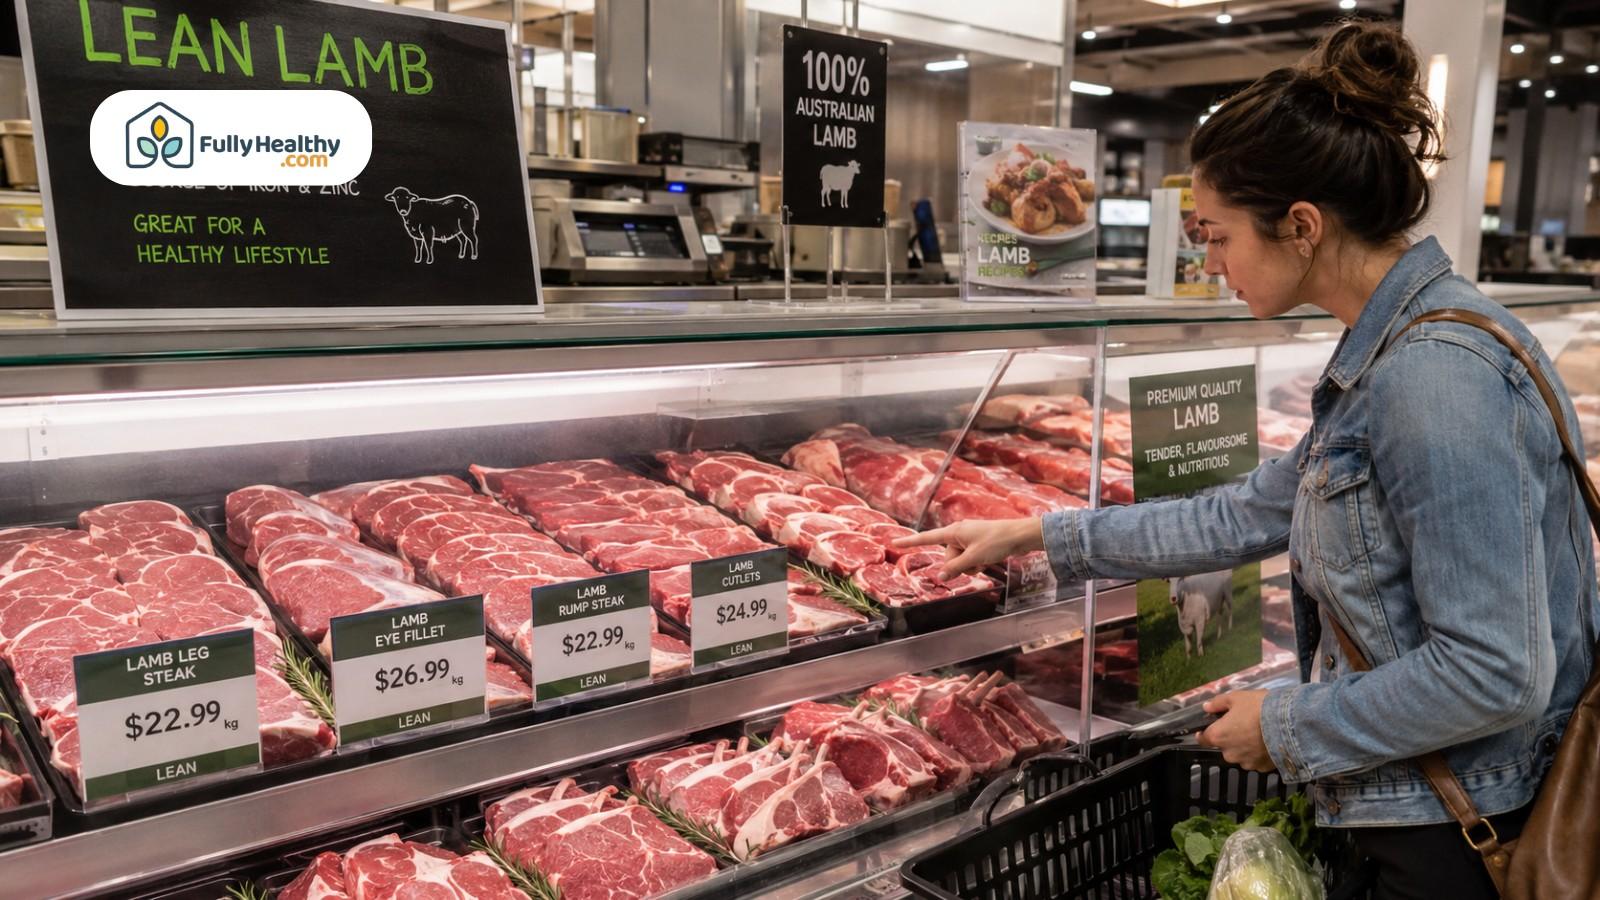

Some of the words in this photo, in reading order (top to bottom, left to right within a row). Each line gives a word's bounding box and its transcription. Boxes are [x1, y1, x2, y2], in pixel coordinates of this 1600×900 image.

[80, 0, 254, 77] LEAN
[275, 25, 434, 95] LAMB
[802, 49, 870, 97] 100%
[795, 96, 875, 123] AUSTRALIAN
[813, 123, 857, 149] LAMB
[133, 214, 197, 234] GREAT
[207, 217, 244, 235] FOR
[252, 217, 266, 236] A
[137, 244, 224, 264] HEALTHY
[234, 246, 330, 265] LIFESTYLE
[977, 246, 1031, 265] LAMB
[1147, 385, 1197, 406] PREMIUM
[1200, 379, 1242, 399] QUALITY
[1173, 402, 1220, 430] LAMB
[1144, 444, 1185, 463] TENDER,
[1186, 433, 1248, 454] FLAVOURSOME
[1168, 464, 1175, 478] &
[1178, 454, 1230, 475] NUTRITIOUS
[729, 560, 754, 573] LAMB
[577, 584, 607, 599] LAMB
[722, 571, 761, 588] CUTLETS
[559, 601, 589, 617] RUMP
[591, 595, 625, 611] STEAK
[716, 598, 768, 626] $24.99
[768, 612, 777, 622] kg
[391, 612, 429, 629] LAMB
[375, 634, 401, 648] EYE
[404, 624, 446, 643] FILLET
[562, 625, 624, 657] $22.99
[624, 640, 635, 651] kg
[126, 652, 174, 672] LAMB
[178, 646, 210, 663] LEG
[730, 642, 753, 656] LEAN
[143, 665, 197, 686] STEAK
[375, 658, 450, 694] $26.99
[451, 675, 464, 686] kg
[580, 674, 607, 689] LEAN
[125, 700, 221, 741] $22.99
[224, 719, 239, 730] kg
[398, 712, 431, 728] LEAN
[156, 761, 197, 781] LEAN
